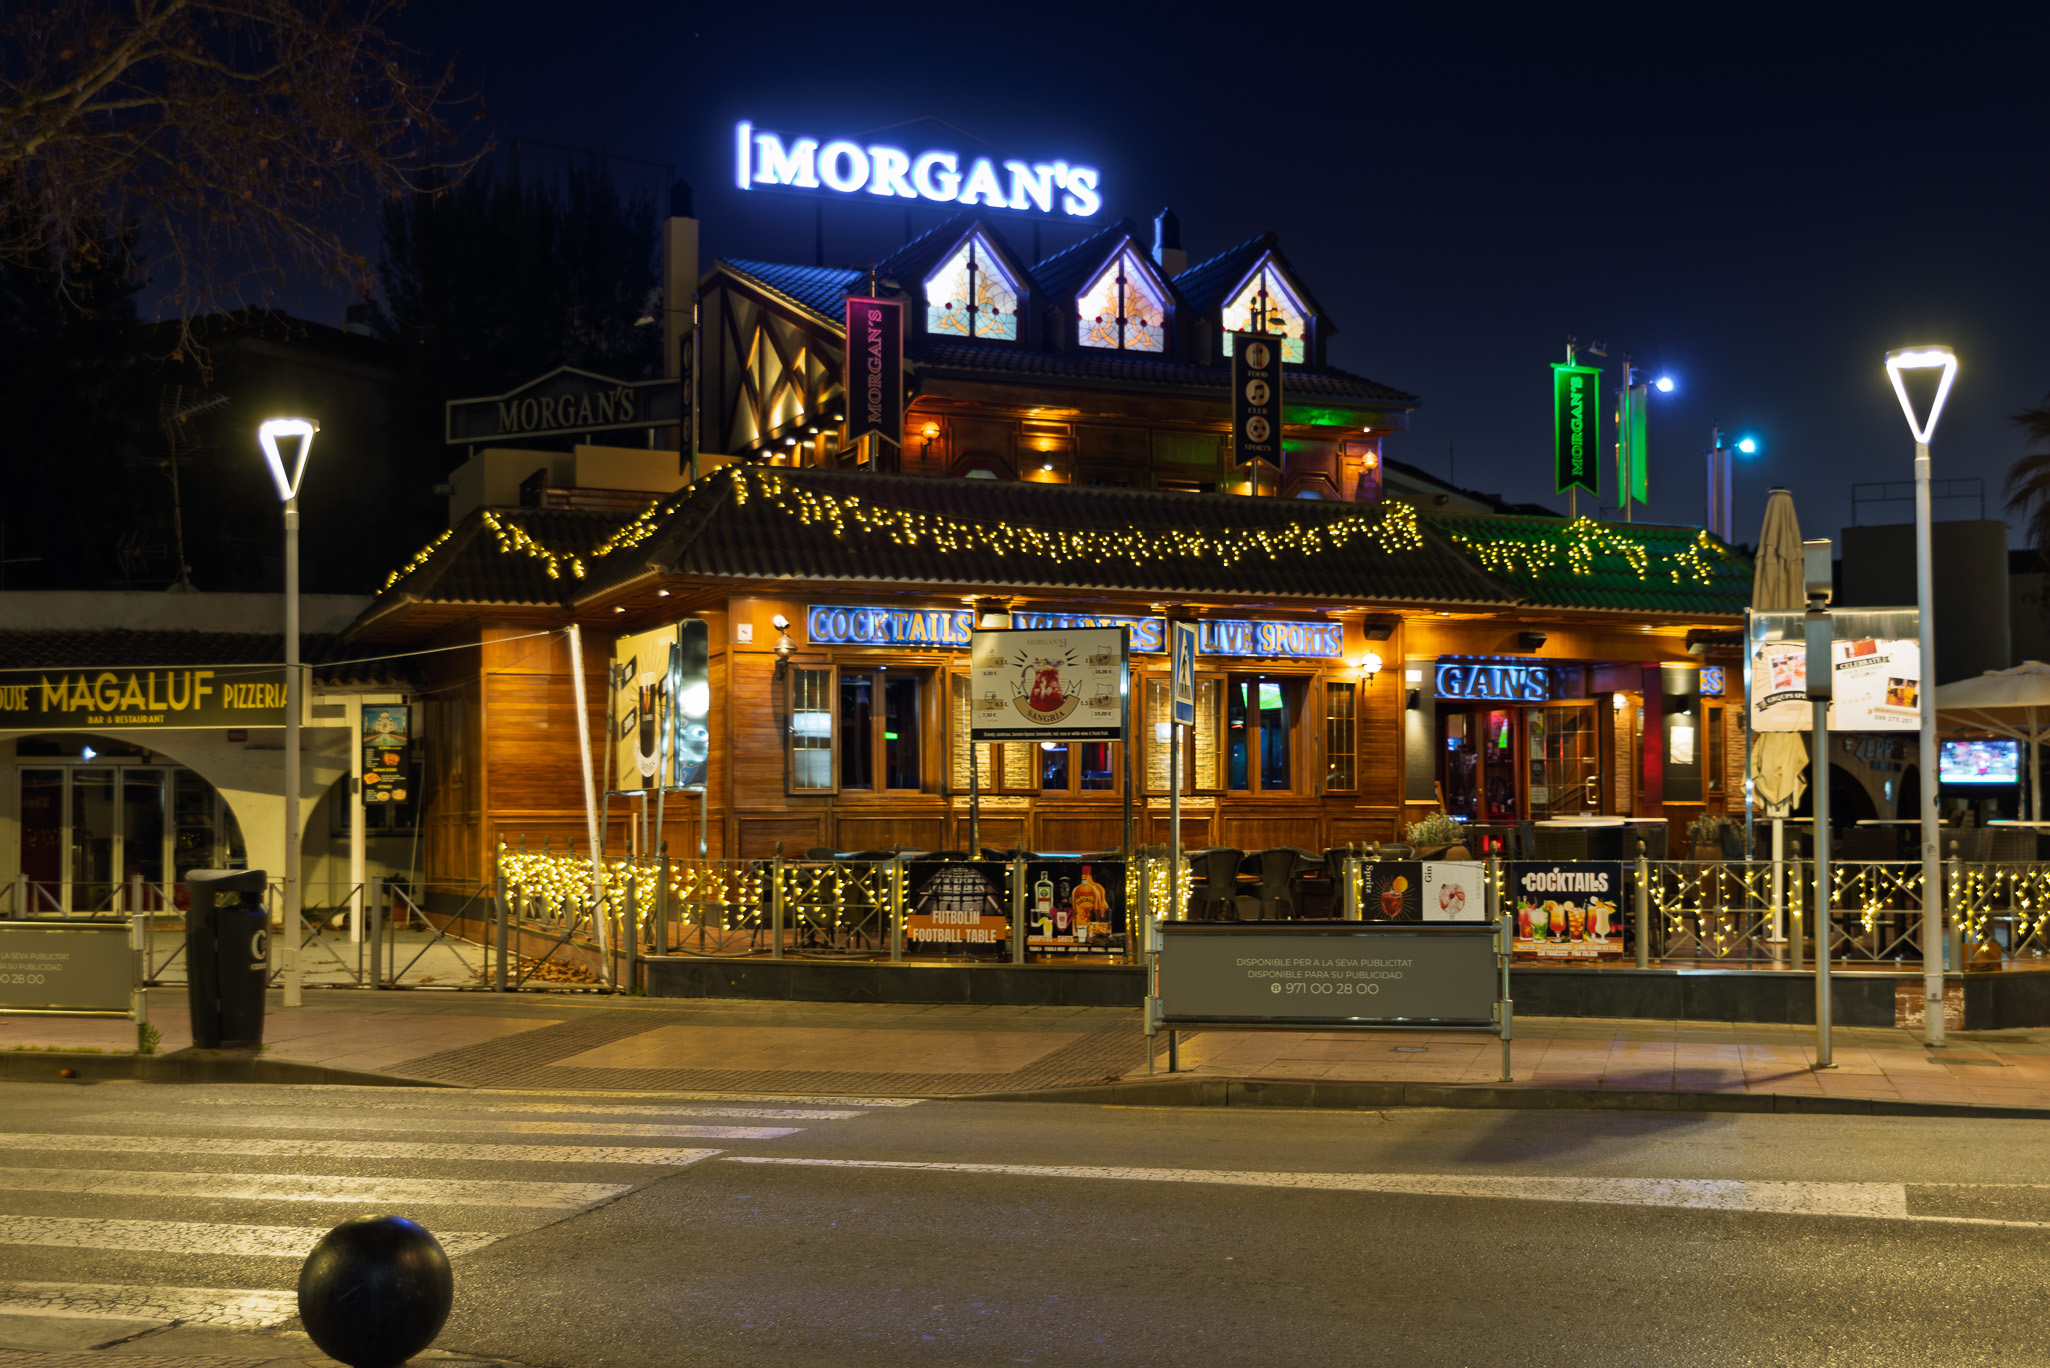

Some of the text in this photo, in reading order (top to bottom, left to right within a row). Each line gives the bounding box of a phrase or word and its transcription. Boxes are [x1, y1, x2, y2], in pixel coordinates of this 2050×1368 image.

[753, 132, 1103, 218] MORGAN'S
[867, 308, 883, 425] MORGAN'S
[1247, 370, 1269, 378] FOOD
[497, 385, 636, 433] MORGAN'S
[1247, 407, 1268, 415] CLUB
[1570, 375, 1584, 477] MORGAN'S
[1244, 443, 1273, 452] SPORTS
[813, 609, 973, 643] COCKTAILS
[1203, 623, 1342, 653] LIVE SPORTS
[1839, 656, 1882, 670] CELEBRATE
[41, 670, 215, 713] MAGALUF
[1766, 693, 1793, 703] GROUPS
[87, 716, 104, 724] BAR
[115, 715, 165, 724] RESTAURANT
[1026, 709, 1066, 723] SANGRÍA
[1364, 864, 1374, 894] Spritz
[1424, 865, 1432, 883] Gin
[1525, 871, 1609, 893] COCKTAILS
[932, 908, 980, 925] FUTBOLÍN
[912, 928, 997, 943] FOOTBALL TABLE
[1028, 934, 1074, 943] CHUPITOS SHOTS
[1, 952, 10, 960] LA
[30, 953, 71, 961] PUBLICITAT
[1236, 958, 1414, 968] DISPONIBLE PER A LA SEVA PUBLICITAT
[19, 963, 63, 971] PUBLICIDAD
[12, 974, 25, 984] 28
[1247, 970, 1403, 980] DISPONIBLE PARA SU PUBLICIDAD
[1285, 982, 1307, 995] 971
[1336, 983, 1354, 995] 28
